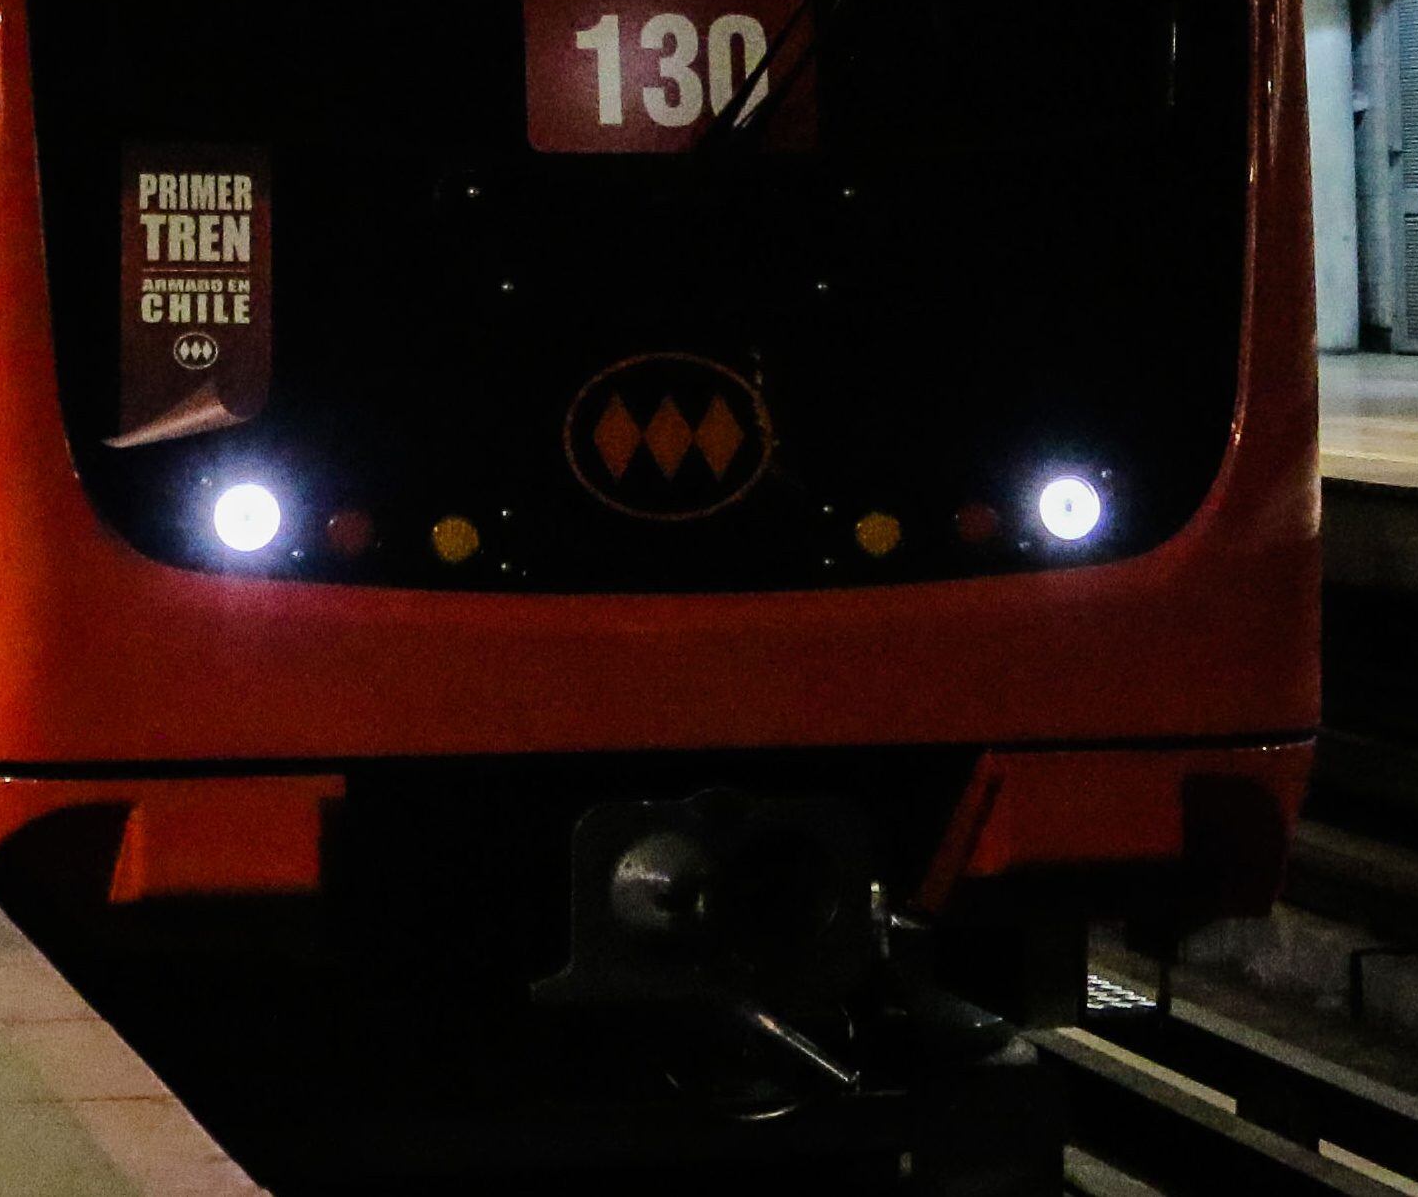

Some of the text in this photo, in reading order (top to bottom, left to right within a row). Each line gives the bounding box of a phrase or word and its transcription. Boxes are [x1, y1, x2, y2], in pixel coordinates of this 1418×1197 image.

[576, 13, 769, 128] 130
[139, 173, 253, 211] PRIMER
[139, 213, 251, 262] TREN
[142, 278, 251, 293] ARMADO EN
[141, 292, 251, 324] CHILE
